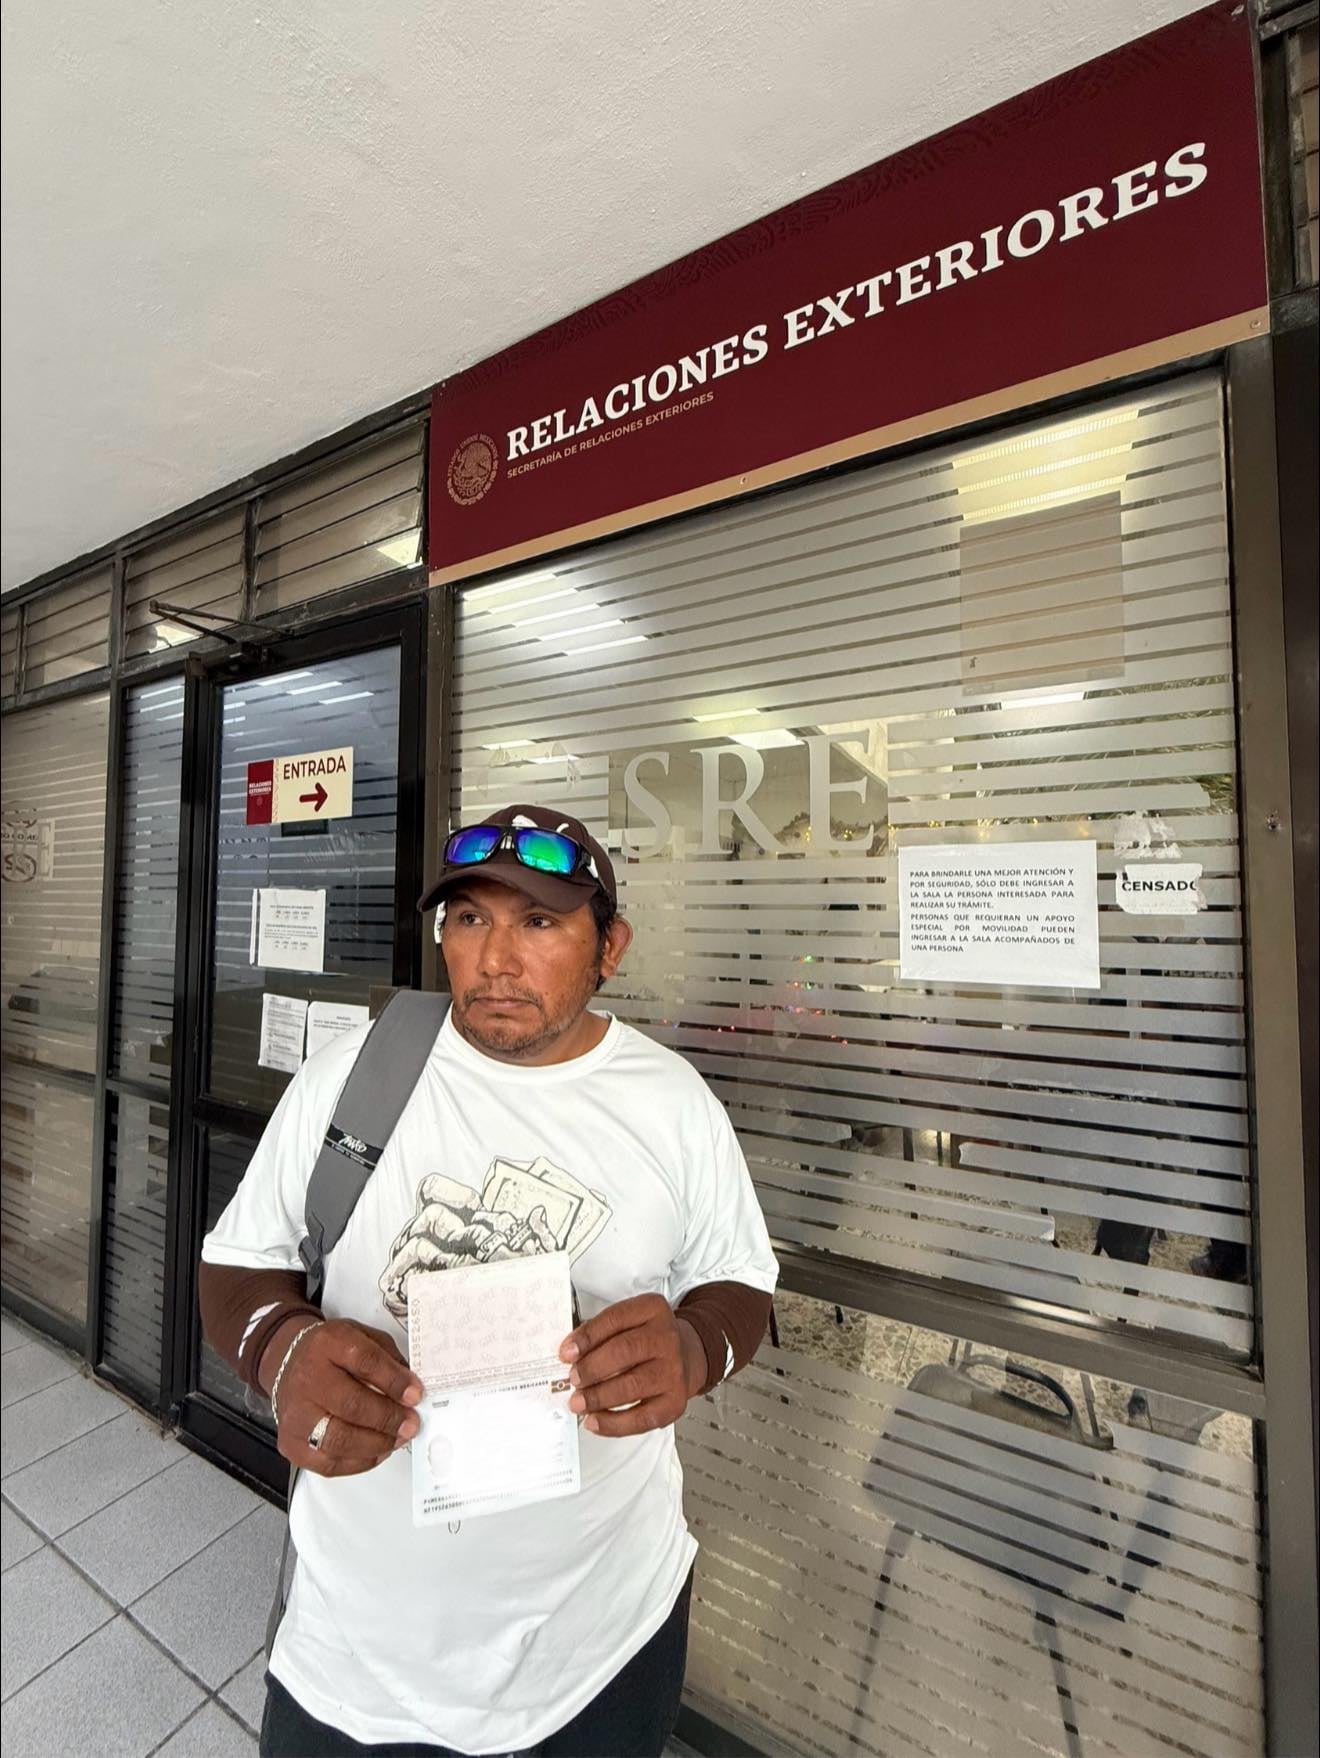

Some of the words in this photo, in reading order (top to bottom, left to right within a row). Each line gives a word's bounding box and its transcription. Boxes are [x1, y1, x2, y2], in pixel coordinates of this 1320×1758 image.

[506, 324, 769, 461] RELACIONES
[783, 142, 1208, 350] EXTERIORES
[506, 450, 562, 479] SECRETARÍA
[564, 443, 577, 457] DE
[579, 419, 643, 451] RELACIONES
[645, 391, 715, 426] EXTERIORES
[283, 755, 346, 780] ENTRADA
[620, 730, 877, 860] SRE
[931, 870, 972, 878] BRINDARLE
[994, 869, 1021, 877] MEJOR
[1023, 867, 1066, 876] ATENCIÓN
[927, 880, 973, 889] SEGURIDAD,
[975, 878, 997, 888] SÓLO
[957, 900, 994, 909] TRÁMITE.
[953, 914, 969, 922] QUE
[975, 914, 1021, 922] REQUIERAN
[911, 934, 947, 942] INGRESAR
[994, 934, 1060, 944] ACOMPAÑADOS
